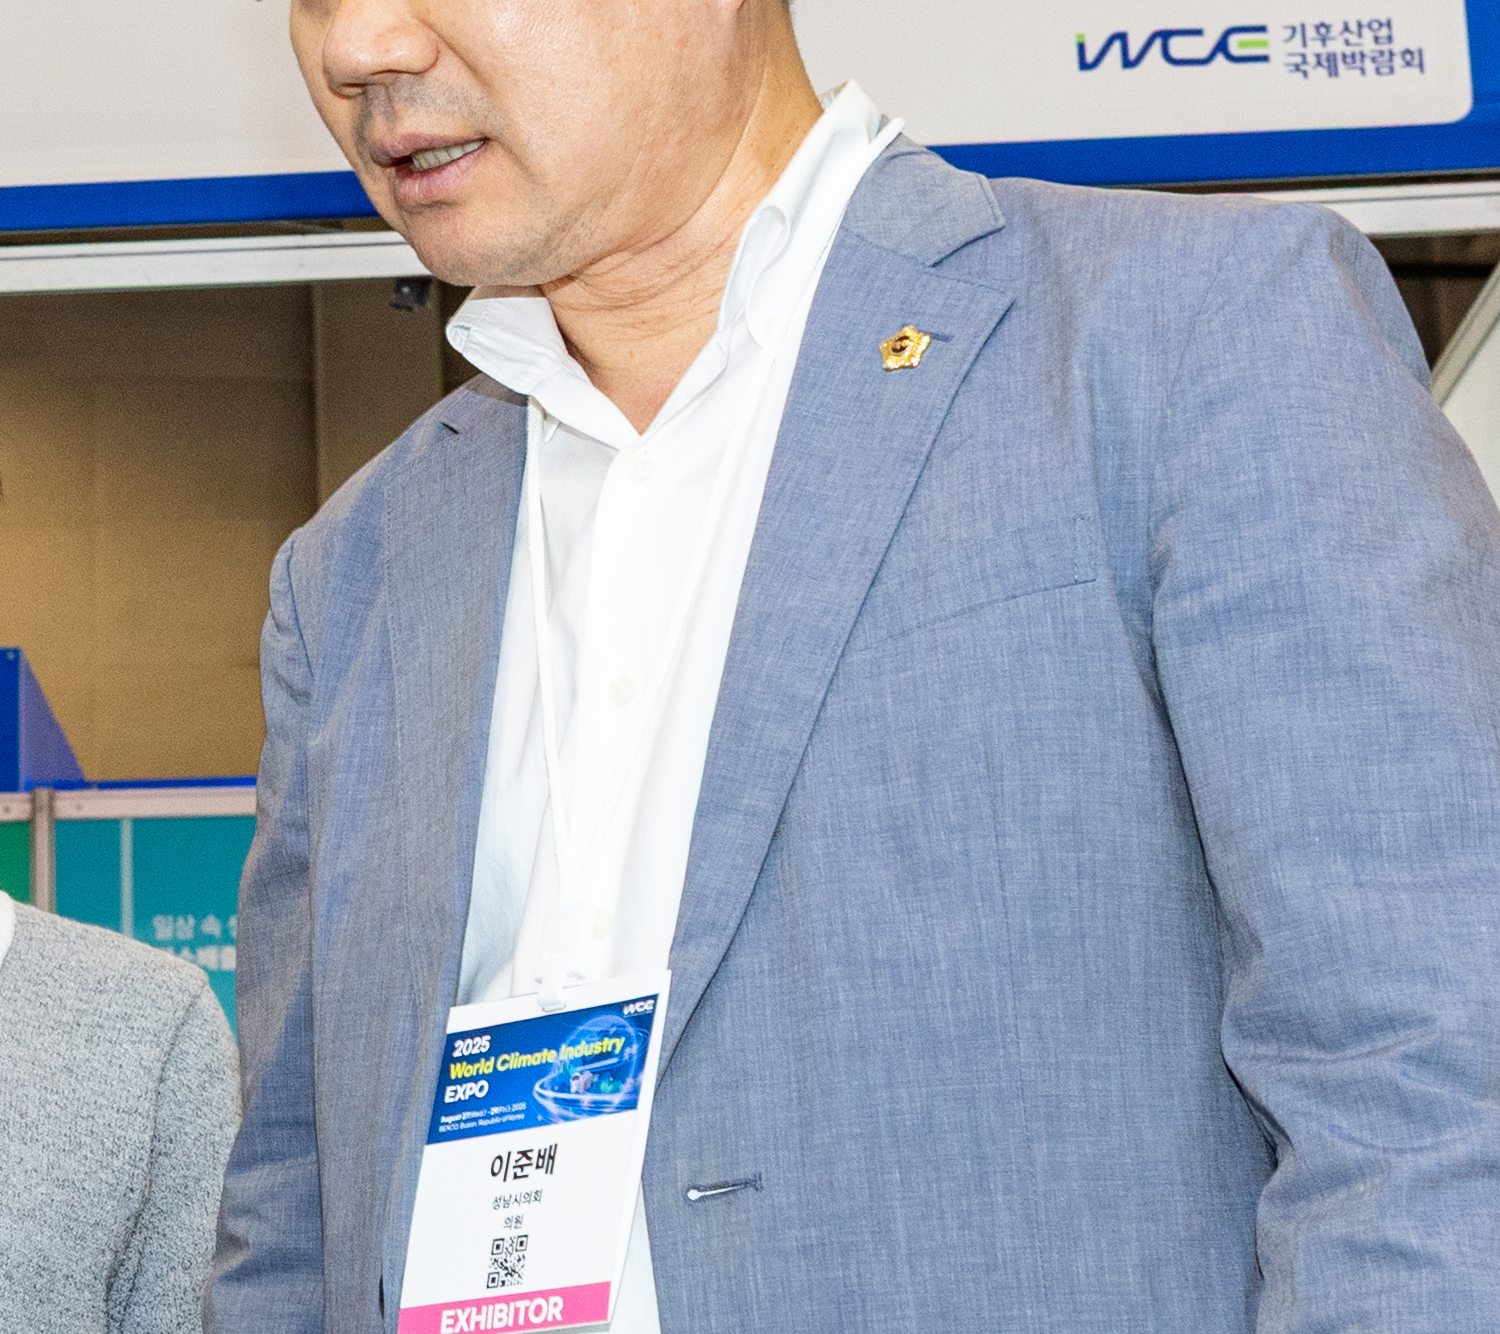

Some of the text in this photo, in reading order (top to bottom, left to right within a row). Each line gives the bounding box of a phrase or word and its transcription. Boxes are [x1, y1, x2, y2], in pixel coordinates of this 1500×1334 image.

[1282, 18, 1395, 49] 기후산업
[1285, 46, 1426, 79] 국제박람회
[450, 1036, 626, 1079] World Climate Industry
[452, 1035, 492, 1058] 2025
[444, 1079, 490, 1104] EXPO
[490, 1143, 559, 1183] 이준배
[491, 1189, 544, 1210] 성남시의회
[440, 1295, 564, 1334] EXHIBITOR
